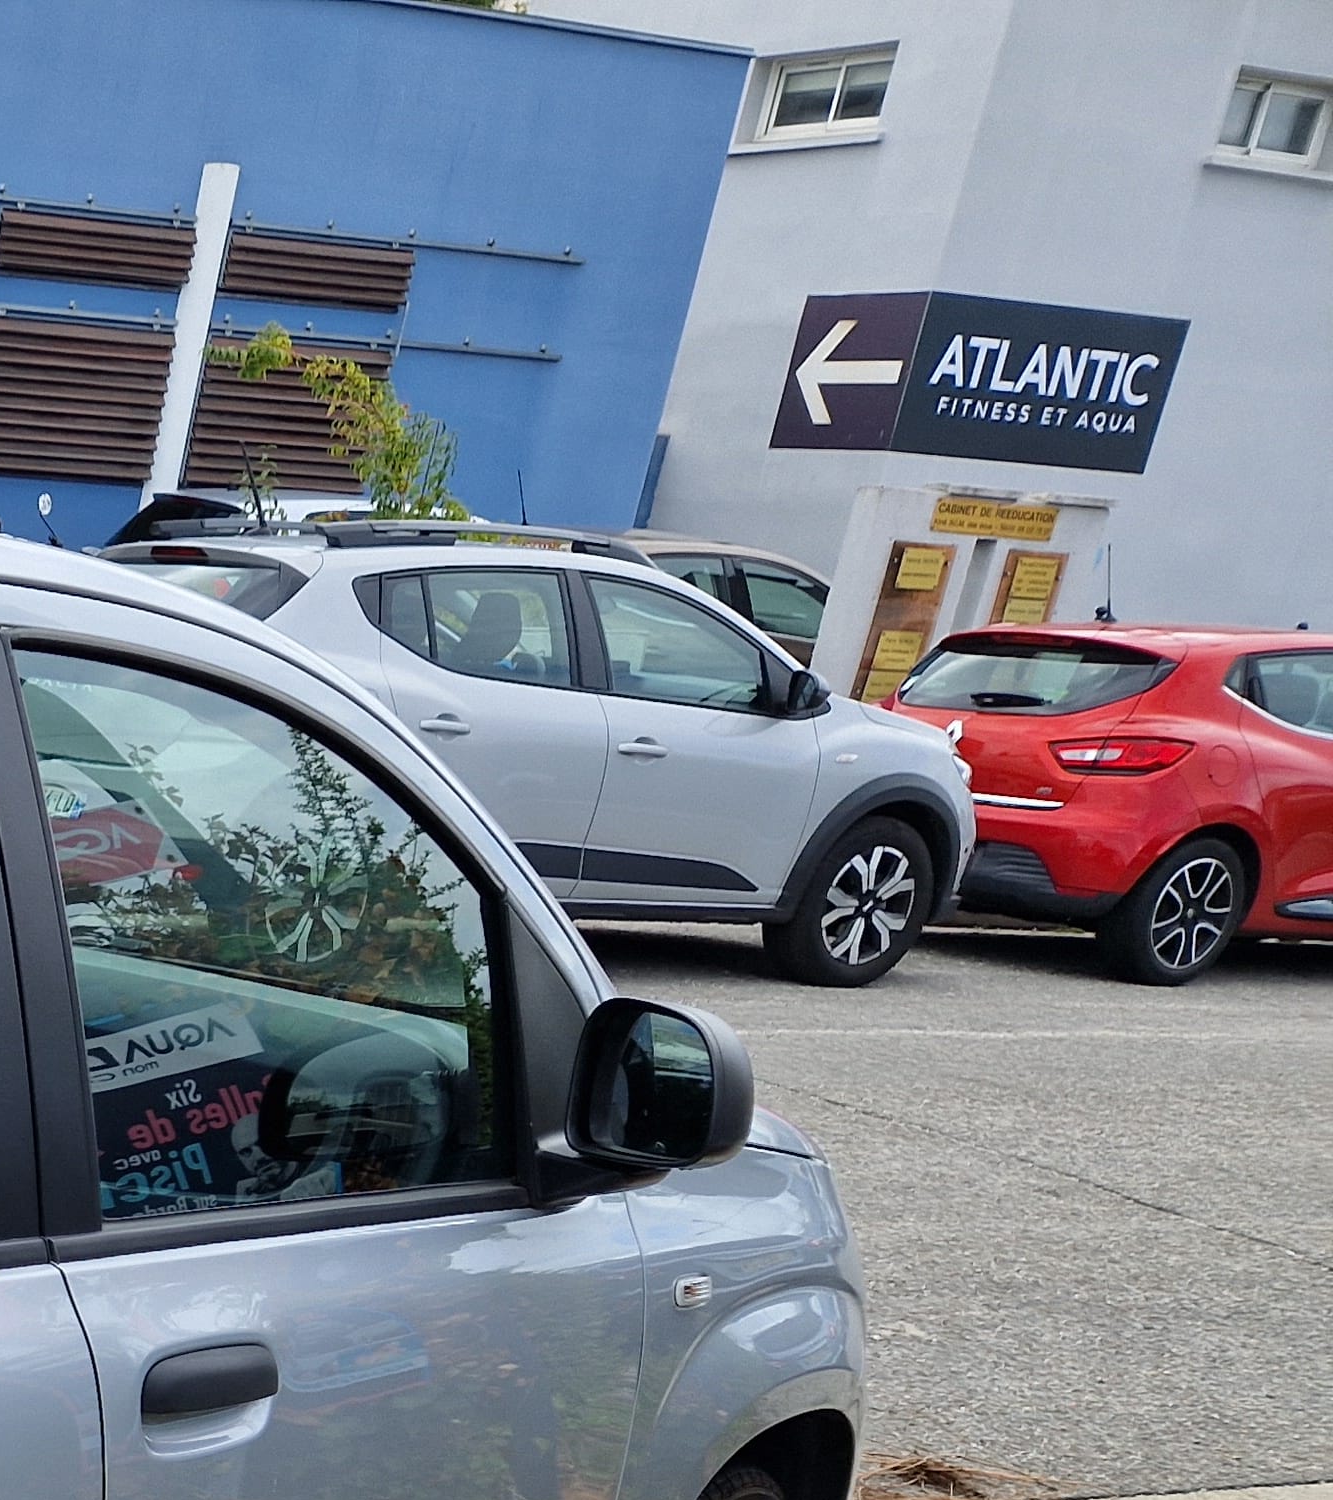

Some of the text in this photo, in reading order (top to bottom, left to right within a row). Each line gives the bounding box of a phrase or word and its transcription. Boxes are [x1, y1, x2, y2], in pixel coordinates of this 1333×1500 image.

[929, 334, 1160, 407] ATLANTIC
[936, 396, 1137, 434] FITNESS ET AQUA
[938, 502, 978, 516] CABINET
[980, 506, 993, 518] DE
